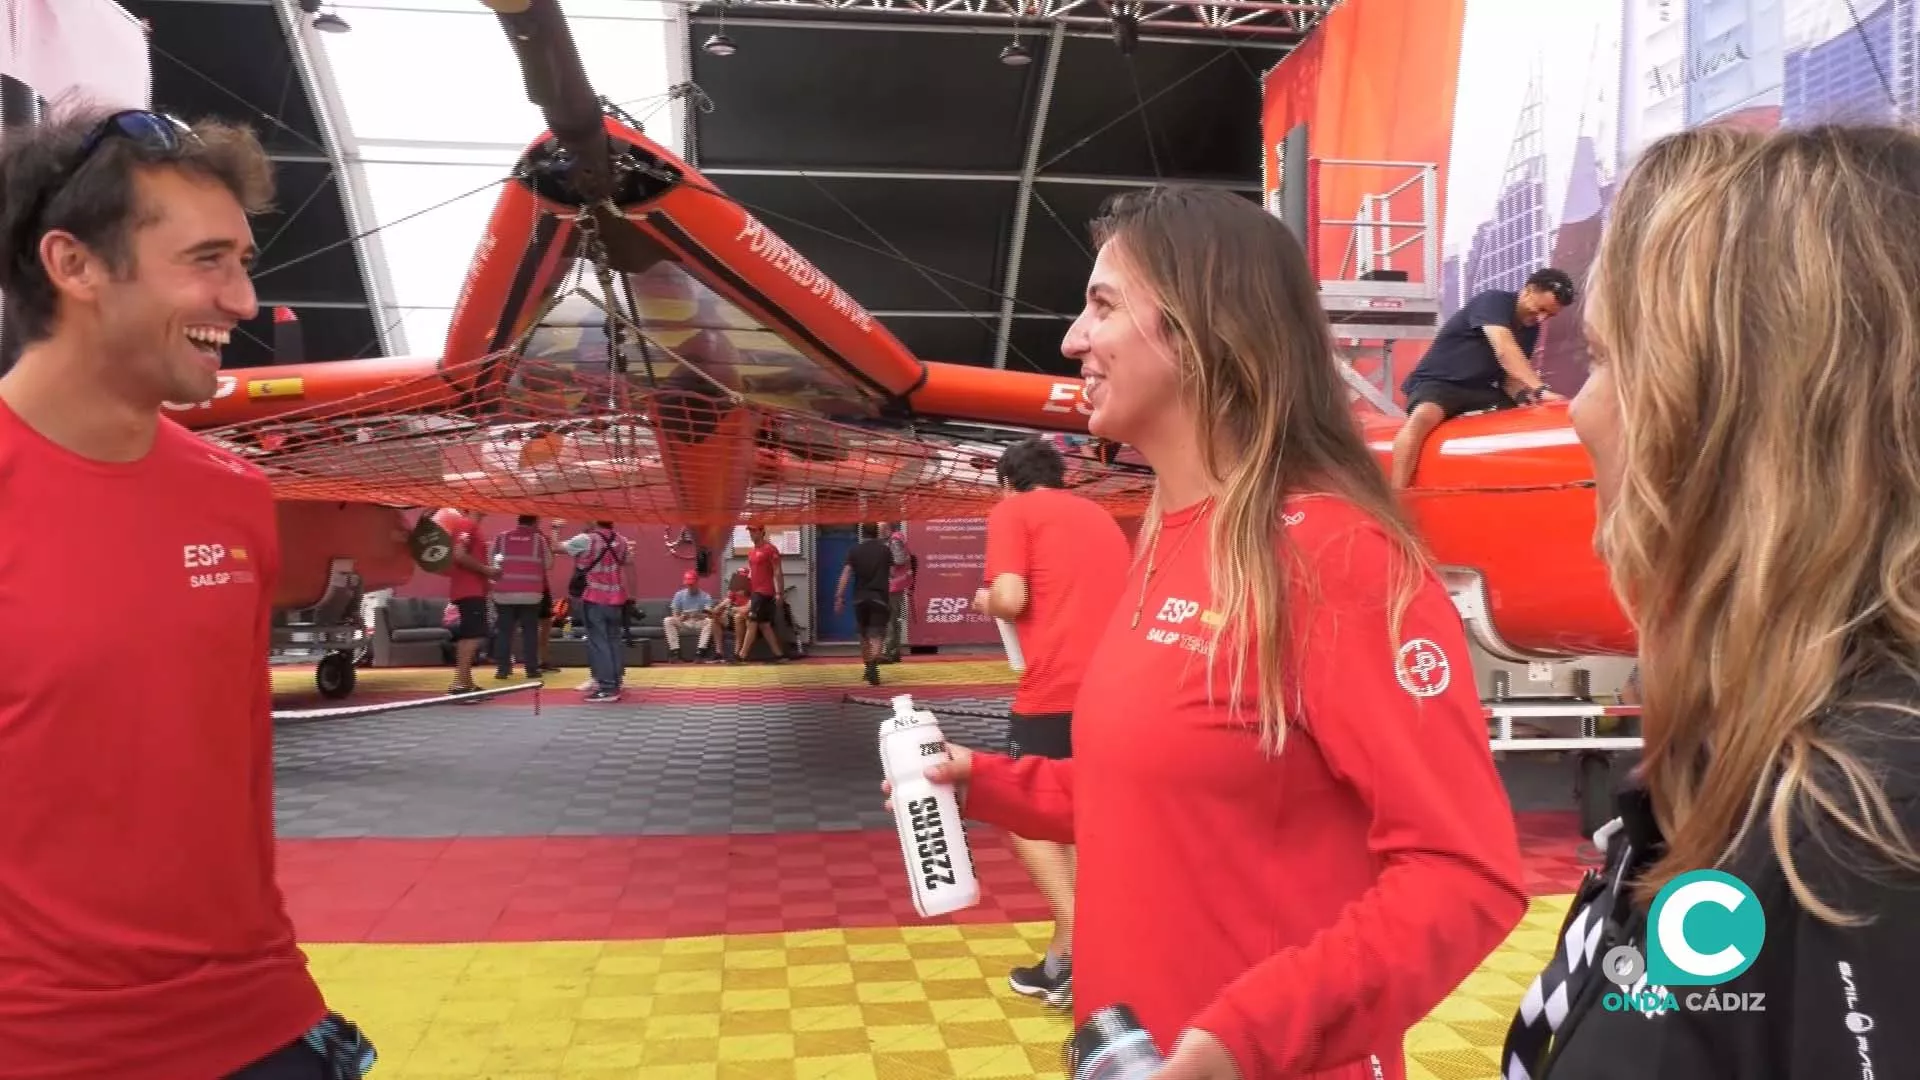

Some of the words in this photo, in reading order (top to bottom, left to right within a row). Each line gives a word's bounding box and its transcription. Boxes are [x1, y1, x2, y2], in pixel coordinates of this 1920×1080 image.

[1042, 383, 1092, 416] ES
[183, 543, 225, 568] ESP
[927, 597, 969, 614] ESP
[1155, 597, 1199, 624] ESP
[908, 795, 956, 890] 226ERS
